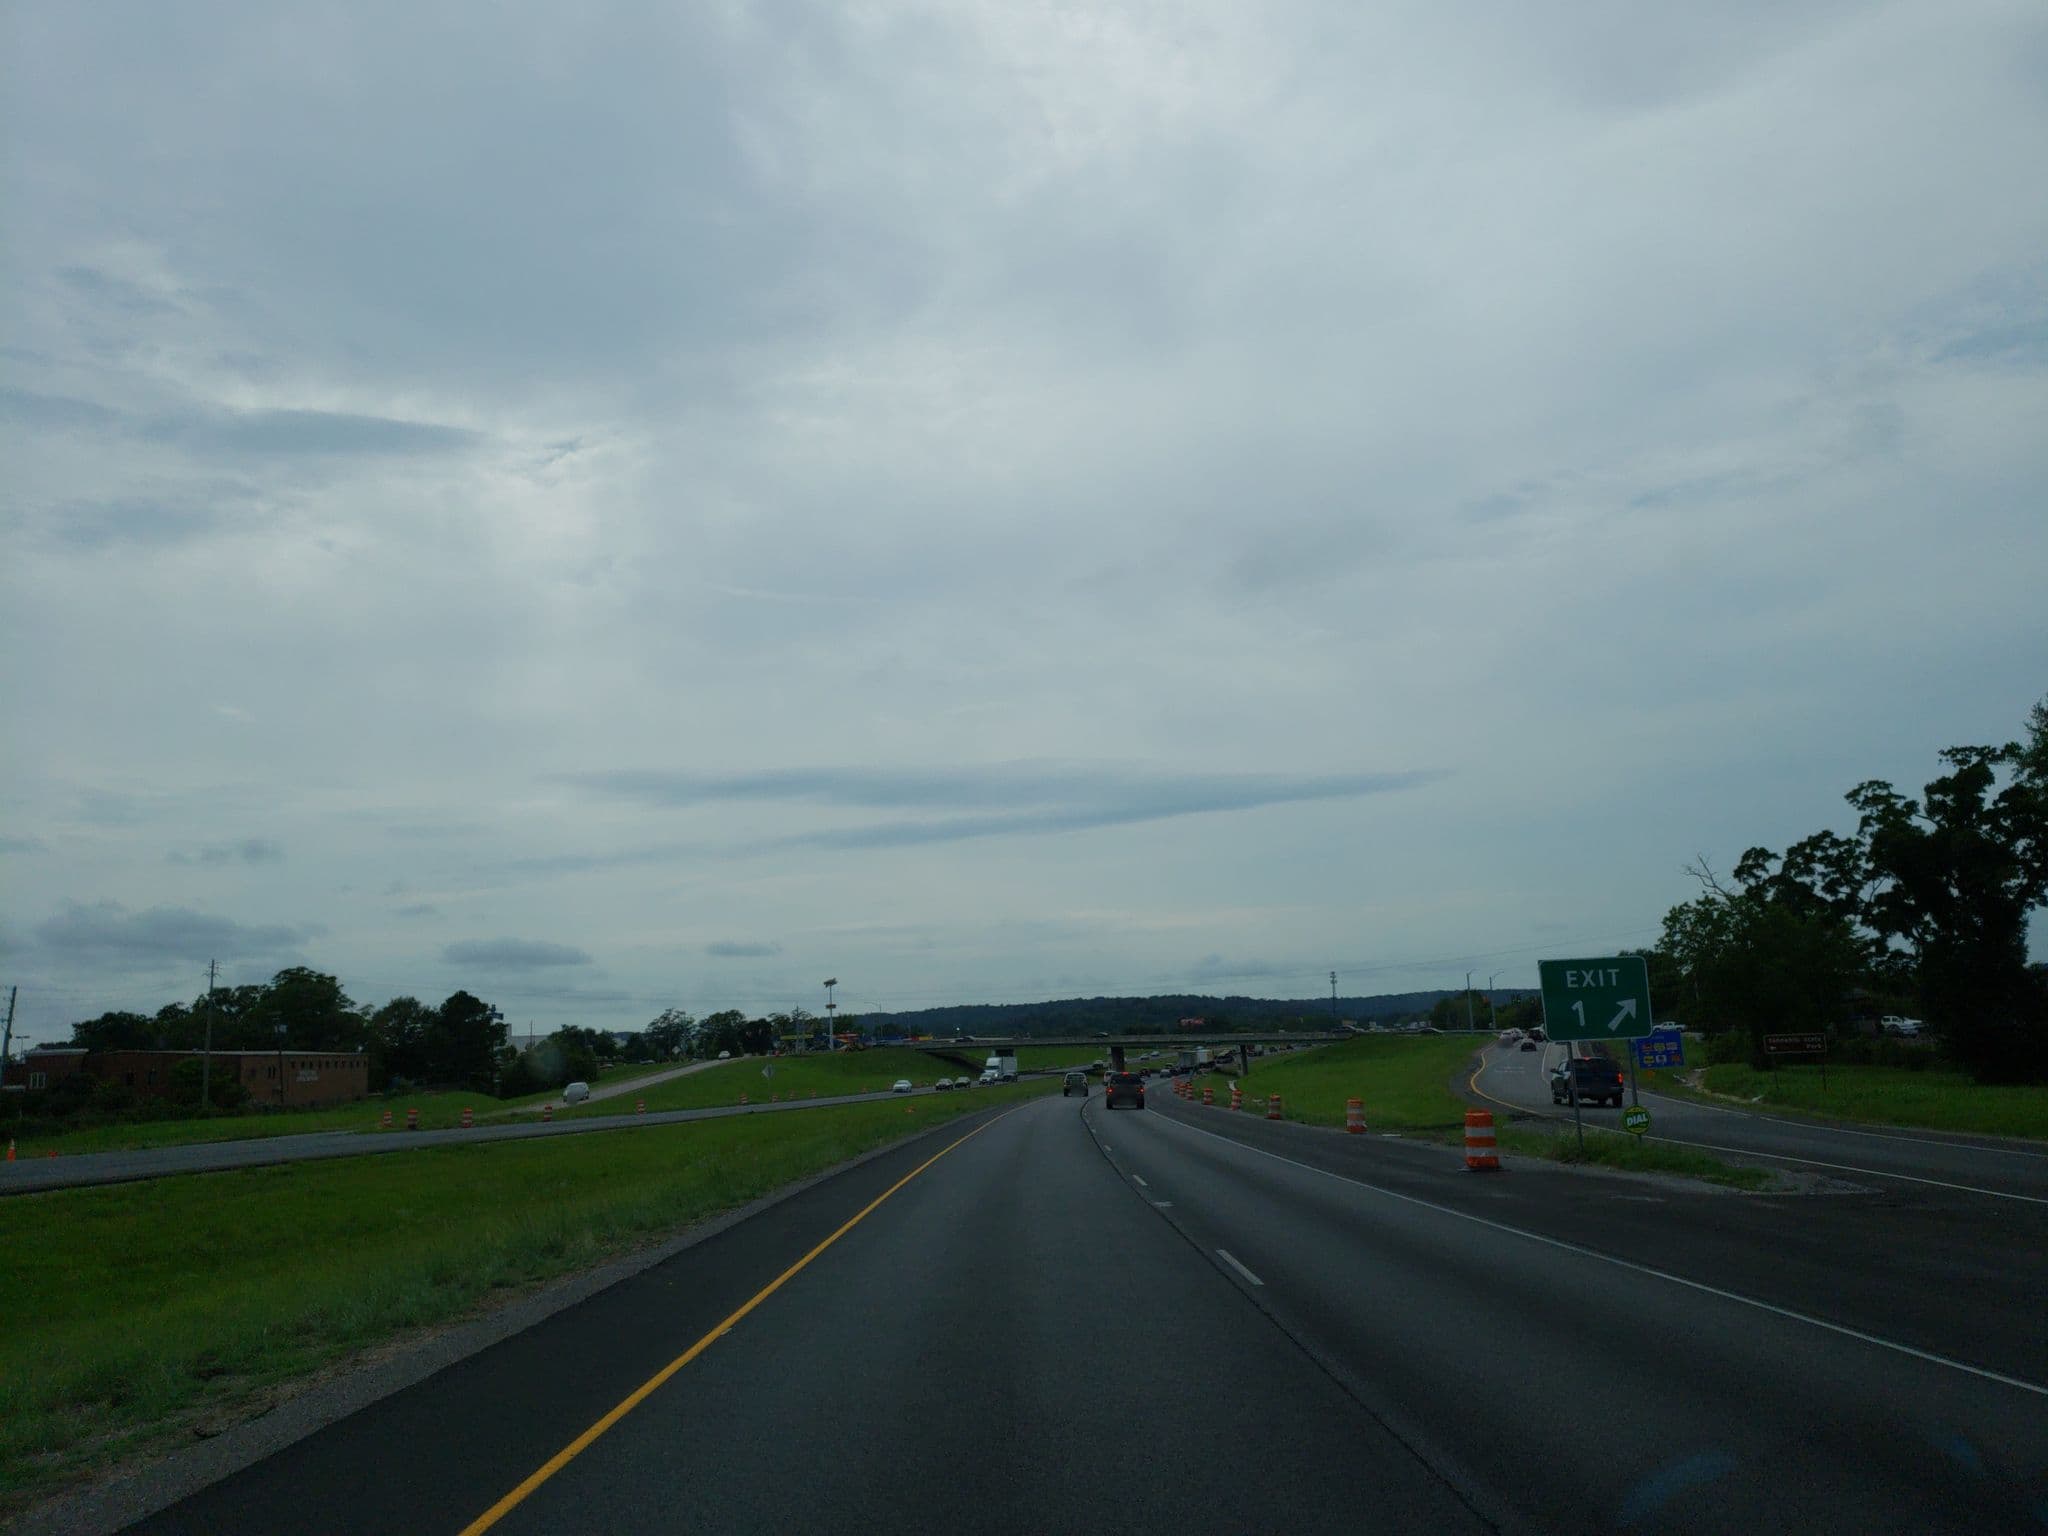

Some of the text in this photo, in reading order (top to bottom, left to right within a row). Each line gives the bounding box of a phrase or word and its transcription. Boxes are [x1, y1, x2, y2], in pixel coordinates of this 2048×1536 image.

[1566, 969, 1619, 988] EXIT
[1571, 1000, 1586, 1026] 1
[1626, 1112, 1648, 1126] DIAL
